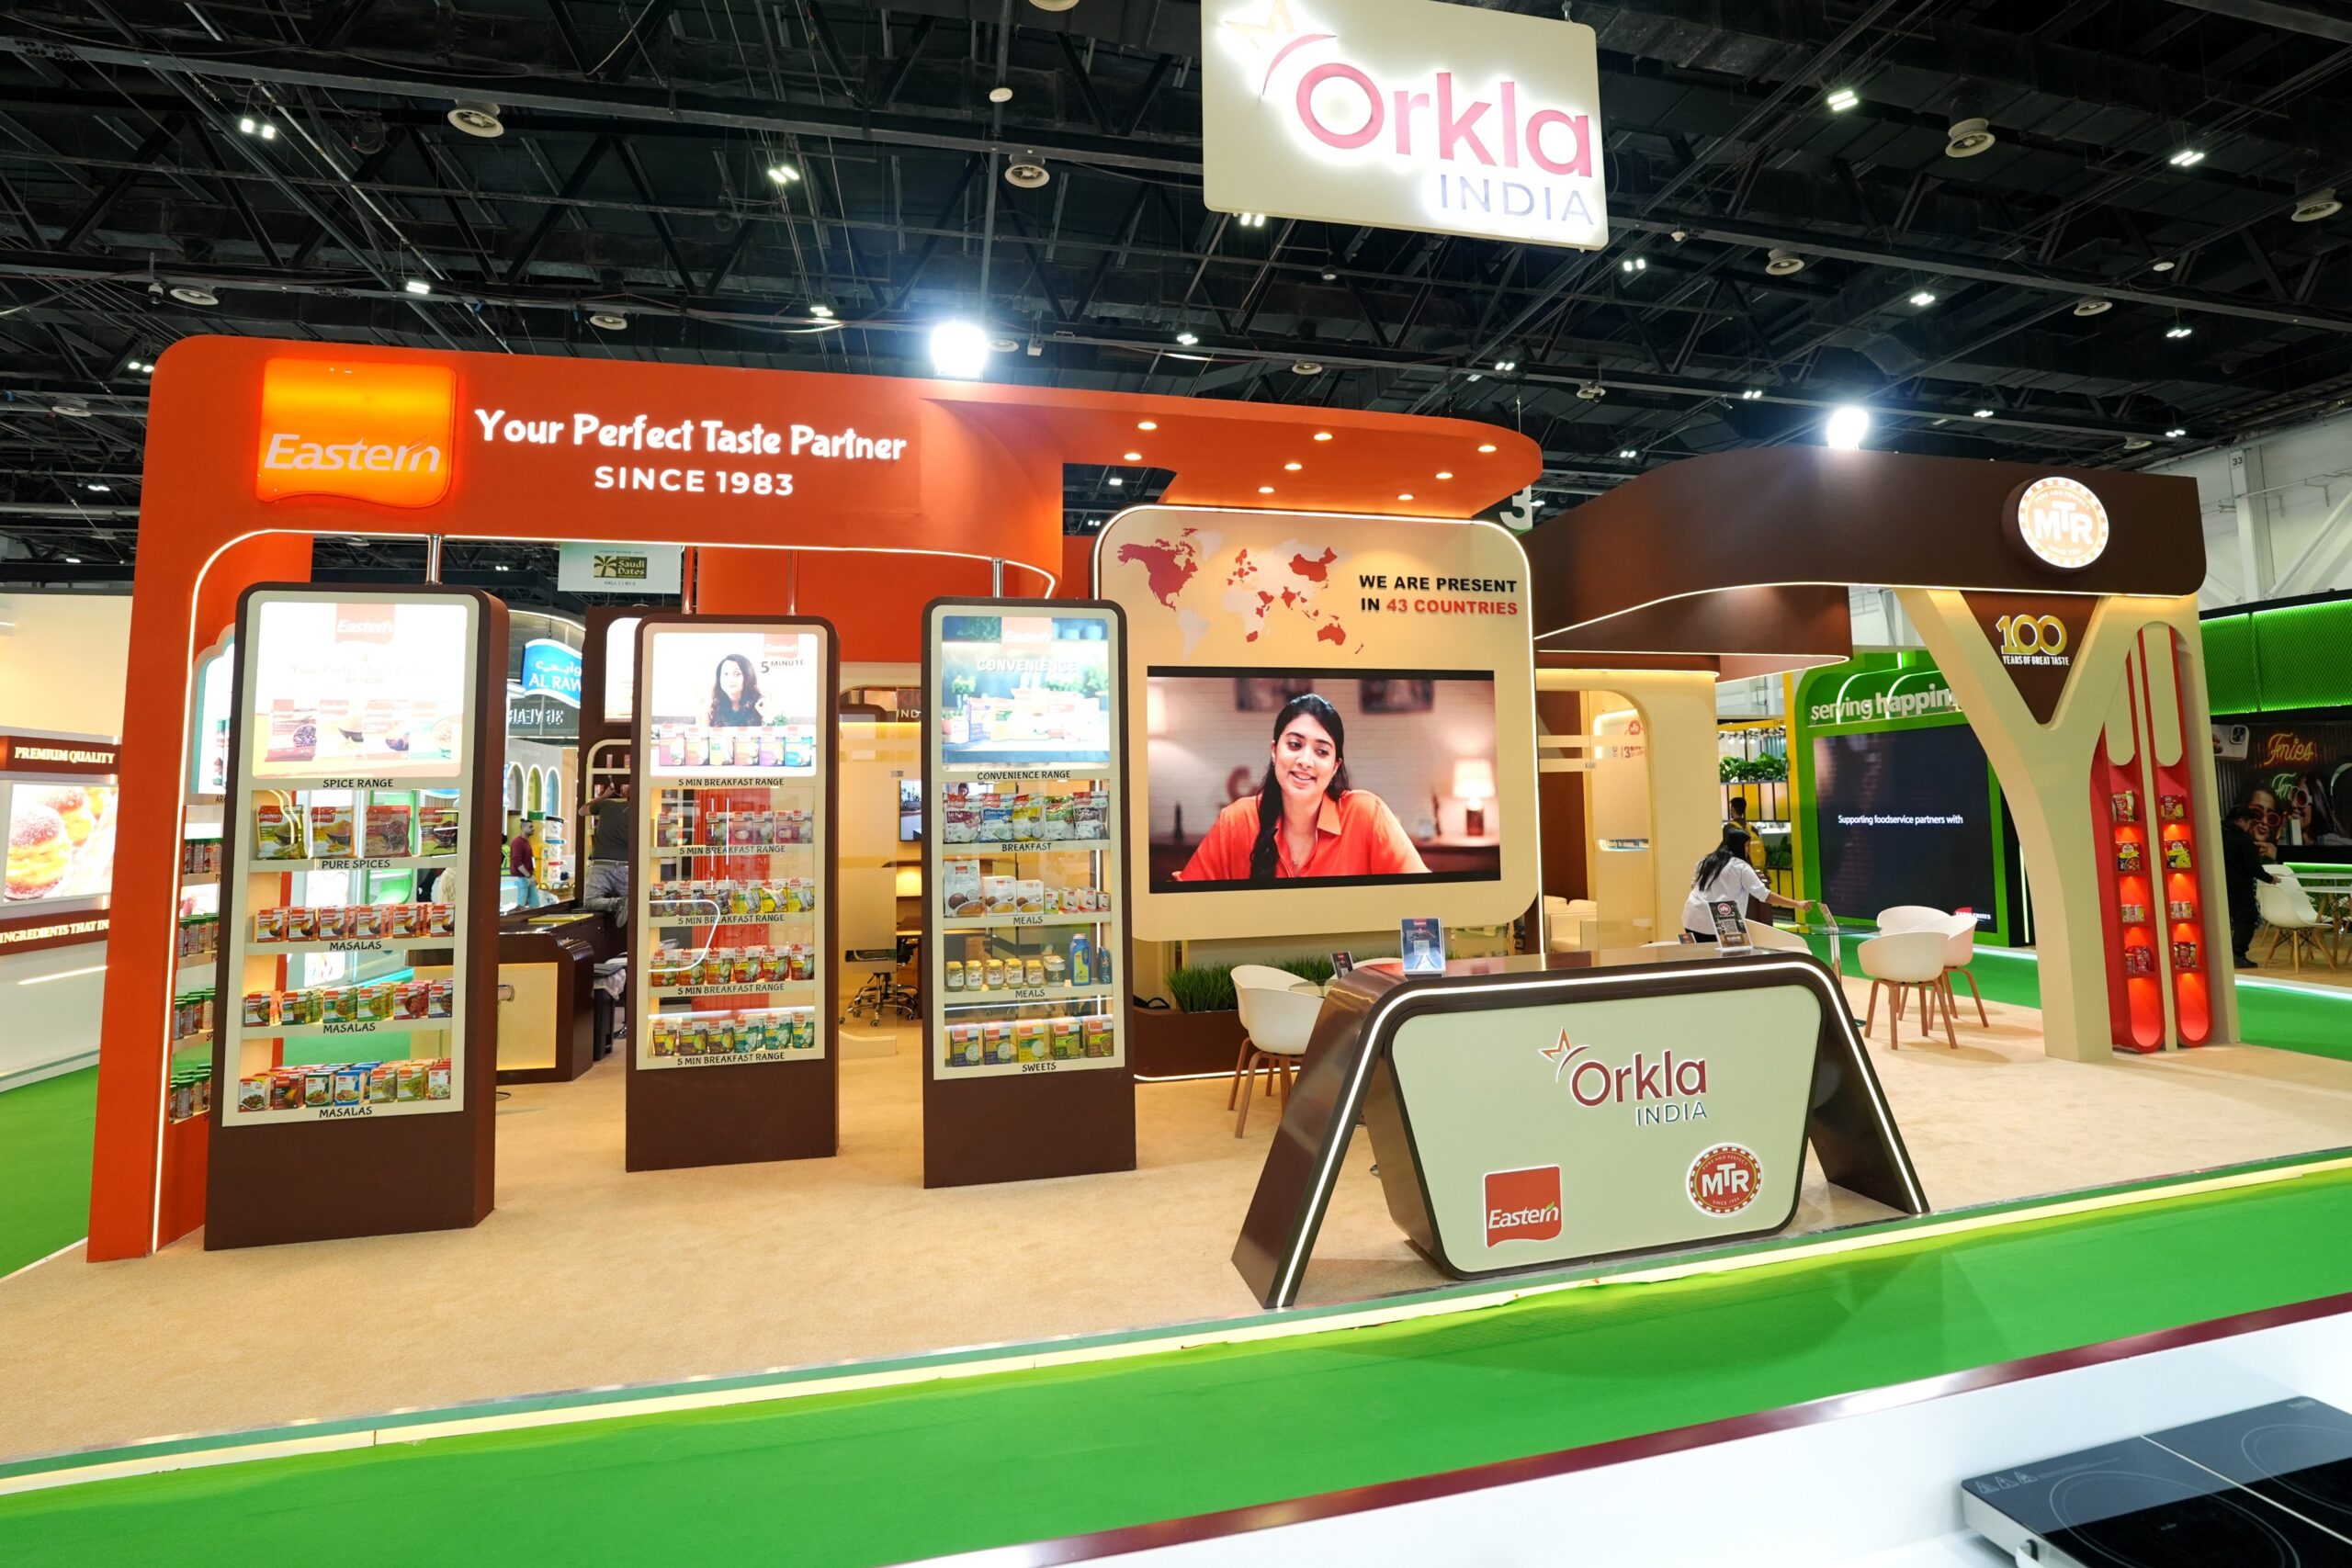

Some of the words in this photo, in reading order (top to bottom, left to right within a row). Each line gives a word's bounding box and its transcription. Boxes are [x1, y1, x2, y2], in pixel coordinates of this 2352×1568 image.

[1296, 62, 1592, 177] Orkla
[1441, 174, 1594, 225] INDIA
[475, 409, 564, 445] Your
[573, 413, 694, 451] Perfect
[701, 421, 781, 455] Taste
[791, 424, 907, 460] Partner
[264, 433, 441, 472] Eastern
[2233, 457, 2243, 466] 33
[594, 466, 705, 492] SINCE
[716, 470, 794, 496] 1983
[2033, 500, 2094, 545] MTR
[617, 559, 645, 568] Saudi
[1360, 575, 1387, 589] WE
[1395, 577, 1430, 590] ARE
[1436, 578, 1517, 592] PRESENT
[1362, 598, 1380, 612] IN
[1386, 599, 1408, 613] 43
[1414, 600, 1518, 615] COUNTRIES
[1996, 614, 2068, 656] 100
[761, 660, 770, 673] 5
[770, 659, 805, 667] MINUTE
[2002, 655, 2023, 665] YEARS
[2023, 656, 2031, 665] OF
[2031, 656, 2051, 665] GREAT
[2051, 656, 2070, 666] TASTE
[529, 672, 548, 687] AL
[1811, 696, 1872, 720] serving
[15, 746, 69, 761] PREMIUM
[69, 750, 116, 763] QUALITY
[2264, 732, 2314, 765] Fries
[977, 772, 1039, 780] CONVENIENCE
[1042, 771, 1071, 779] RANGE
[322, 778, 354, 788] SPICE
[357, 778, 393, 787] RANGE
[1838, 815, 1874, 826] Supporting
[1874, 815, 1914, 824] foodservice
[1915, 816, 1946, 826] partners
[1946, 815, 1963, 824] with
[706, 846, 755, 854] BREAKFAST
[756, 845, 786, 853] RANGE
[1001, 842, 1052, 852] BREAKFAST
[322, 860, 349, 869] PURE
[353, 859, 390, 869] SPICES
[756, 914, 785, 922] RANGE
[1012, 917, 1044, 925] MEALS
[0, 924, 70, 943] INGREDIENTS
[70, 920, 96, 934] THAT
[330, 941, 382, 952] MASALAS
[685, 987, 702, 995] MIN
[704, 985, 754, 994] BREAKFAST
[755, 983, 785, 991] RANGE
[1015, 989, 1046, 998] MEALS
[323, 1022, 376, 1034] MASALAS
[704, 1055, 754, 1064] BREAKFAST
[756, 1053, 786, 1061] RANGE
[1022, 1062, 1057, 1072] SWEETS
[1571, 1049, 1707, 1107] Orkla
[320, 1107, 372, 1118] MASALAS
[1636, 1100, 1707, 1126] INDIA
[1702, 1159, 1715, 1170] PURE
[1727, 1155, 1747, 1166] PERFECT
[1702, 1163, 1750, 1198] MTR
[1488, 1206, 1559, 1229] Eastern
